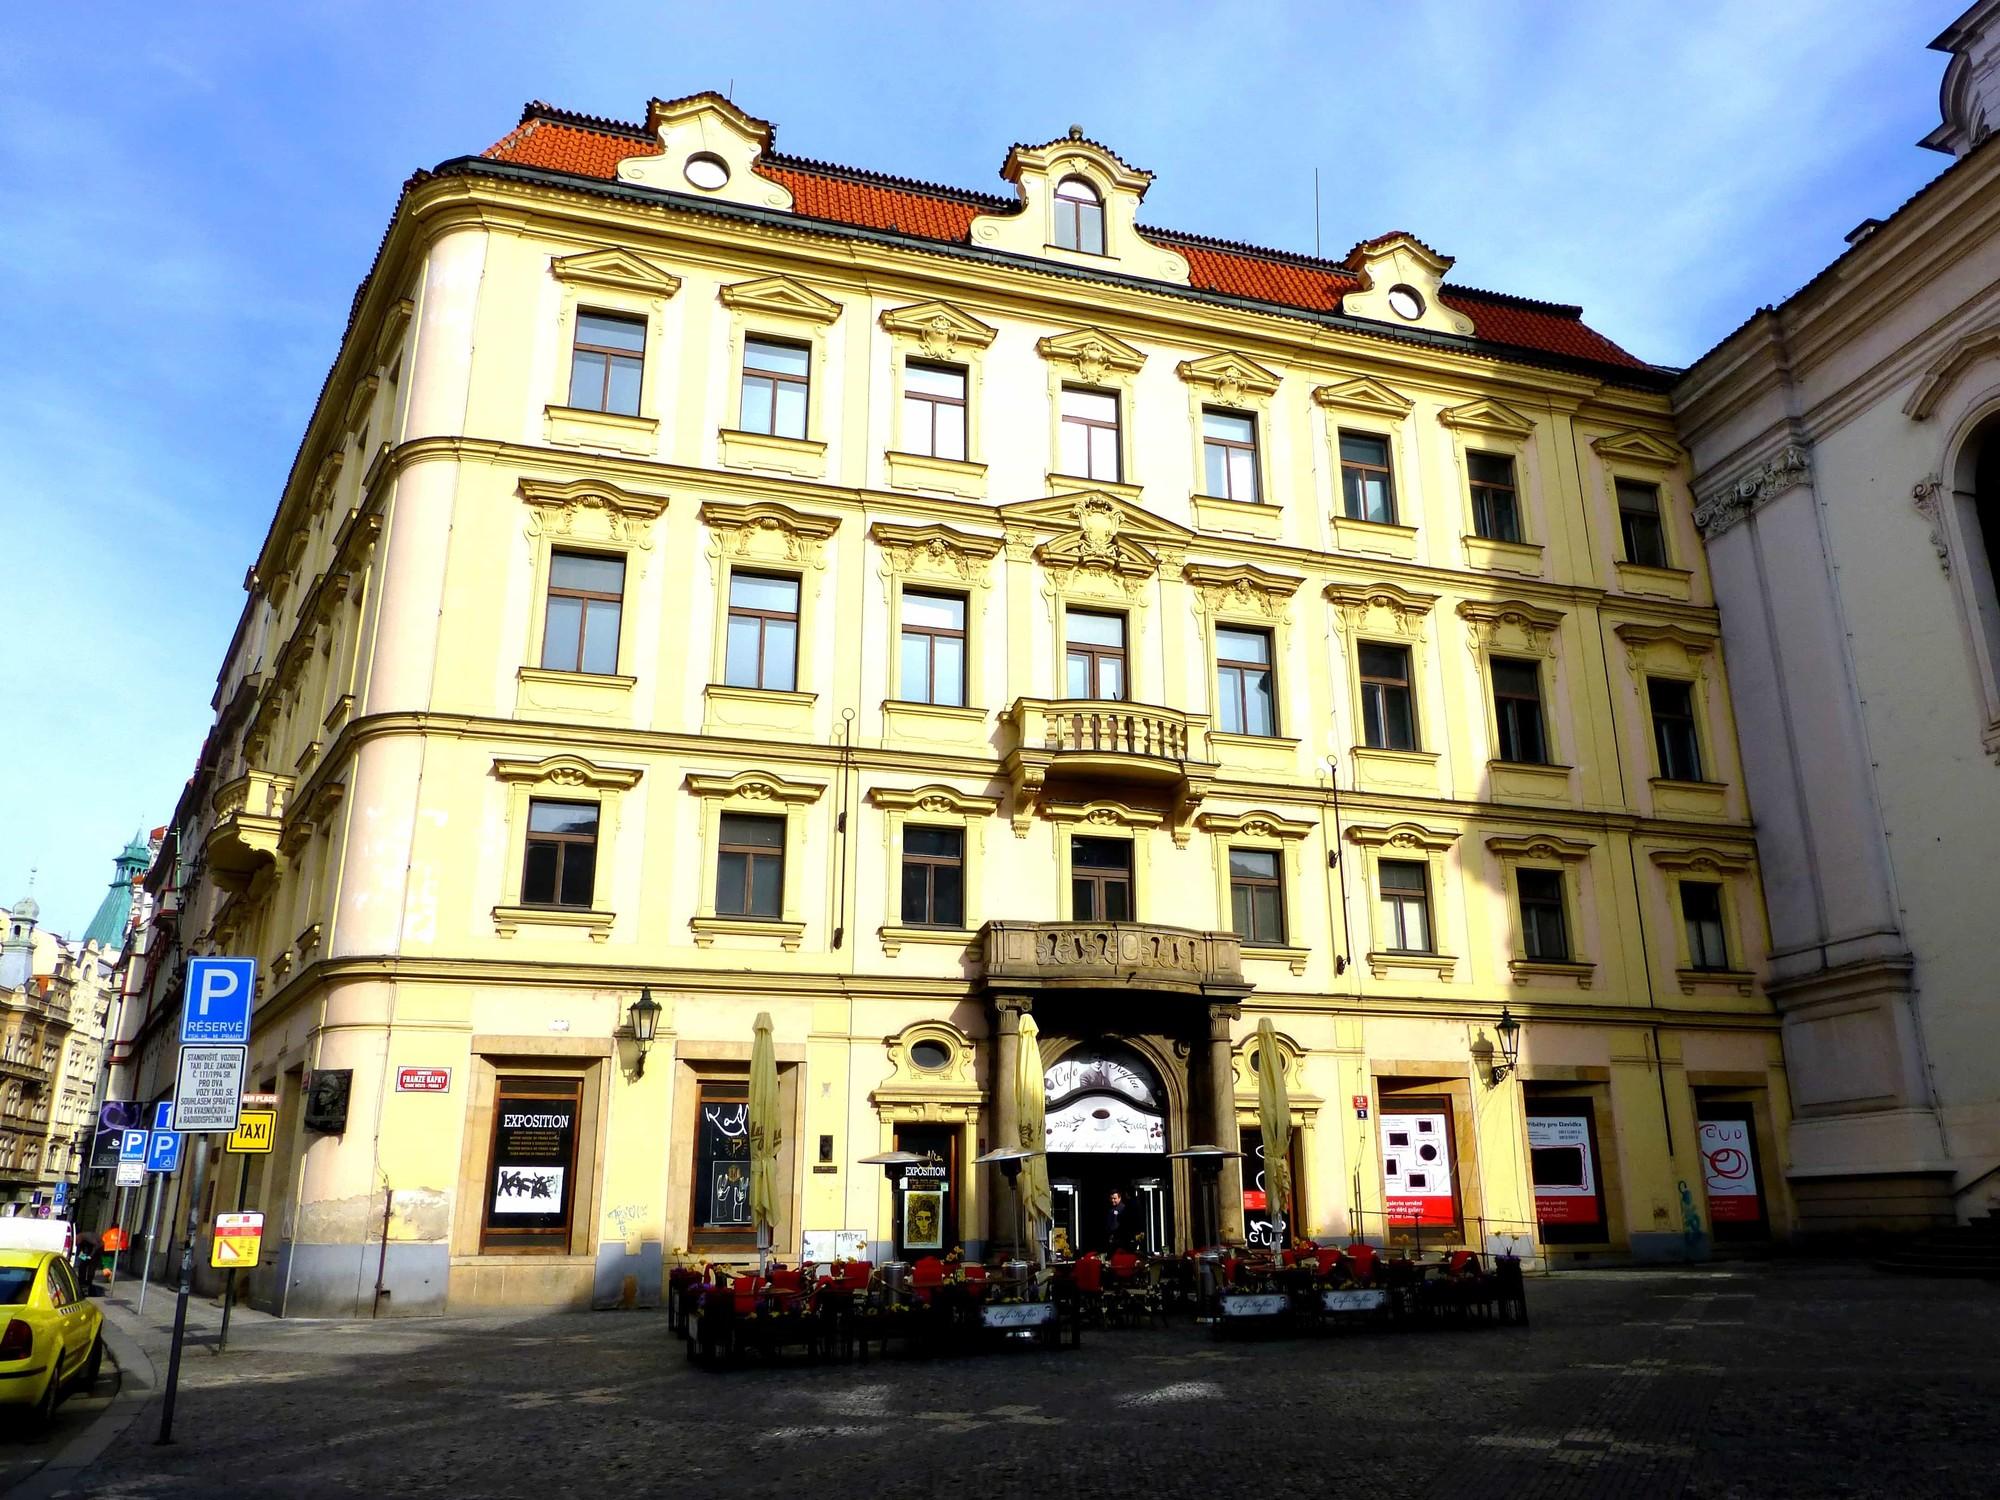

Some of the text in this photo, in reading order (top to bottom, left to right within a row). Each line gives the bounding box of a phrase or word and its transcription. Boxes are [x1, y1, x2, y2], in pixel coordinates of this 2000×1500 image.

[200, 969, 238, 1015] P
[187, 1019, 243, 1032] RÉSERVÉ
[1109, 1061, 1144, 1088] Kafka
[181, 1097, 211, 1105] SOUHLASEM
[503, 1114, 569, 1128] EXPOSITION
[240, 1124, 266, 1139] TAXI
[126, 1133, 142, 1151] P
[155, 1136, 174, 1158] P
[905, 1167, 946, 1176] EXPOSITION
[56, 1194, 63, 1202] P
